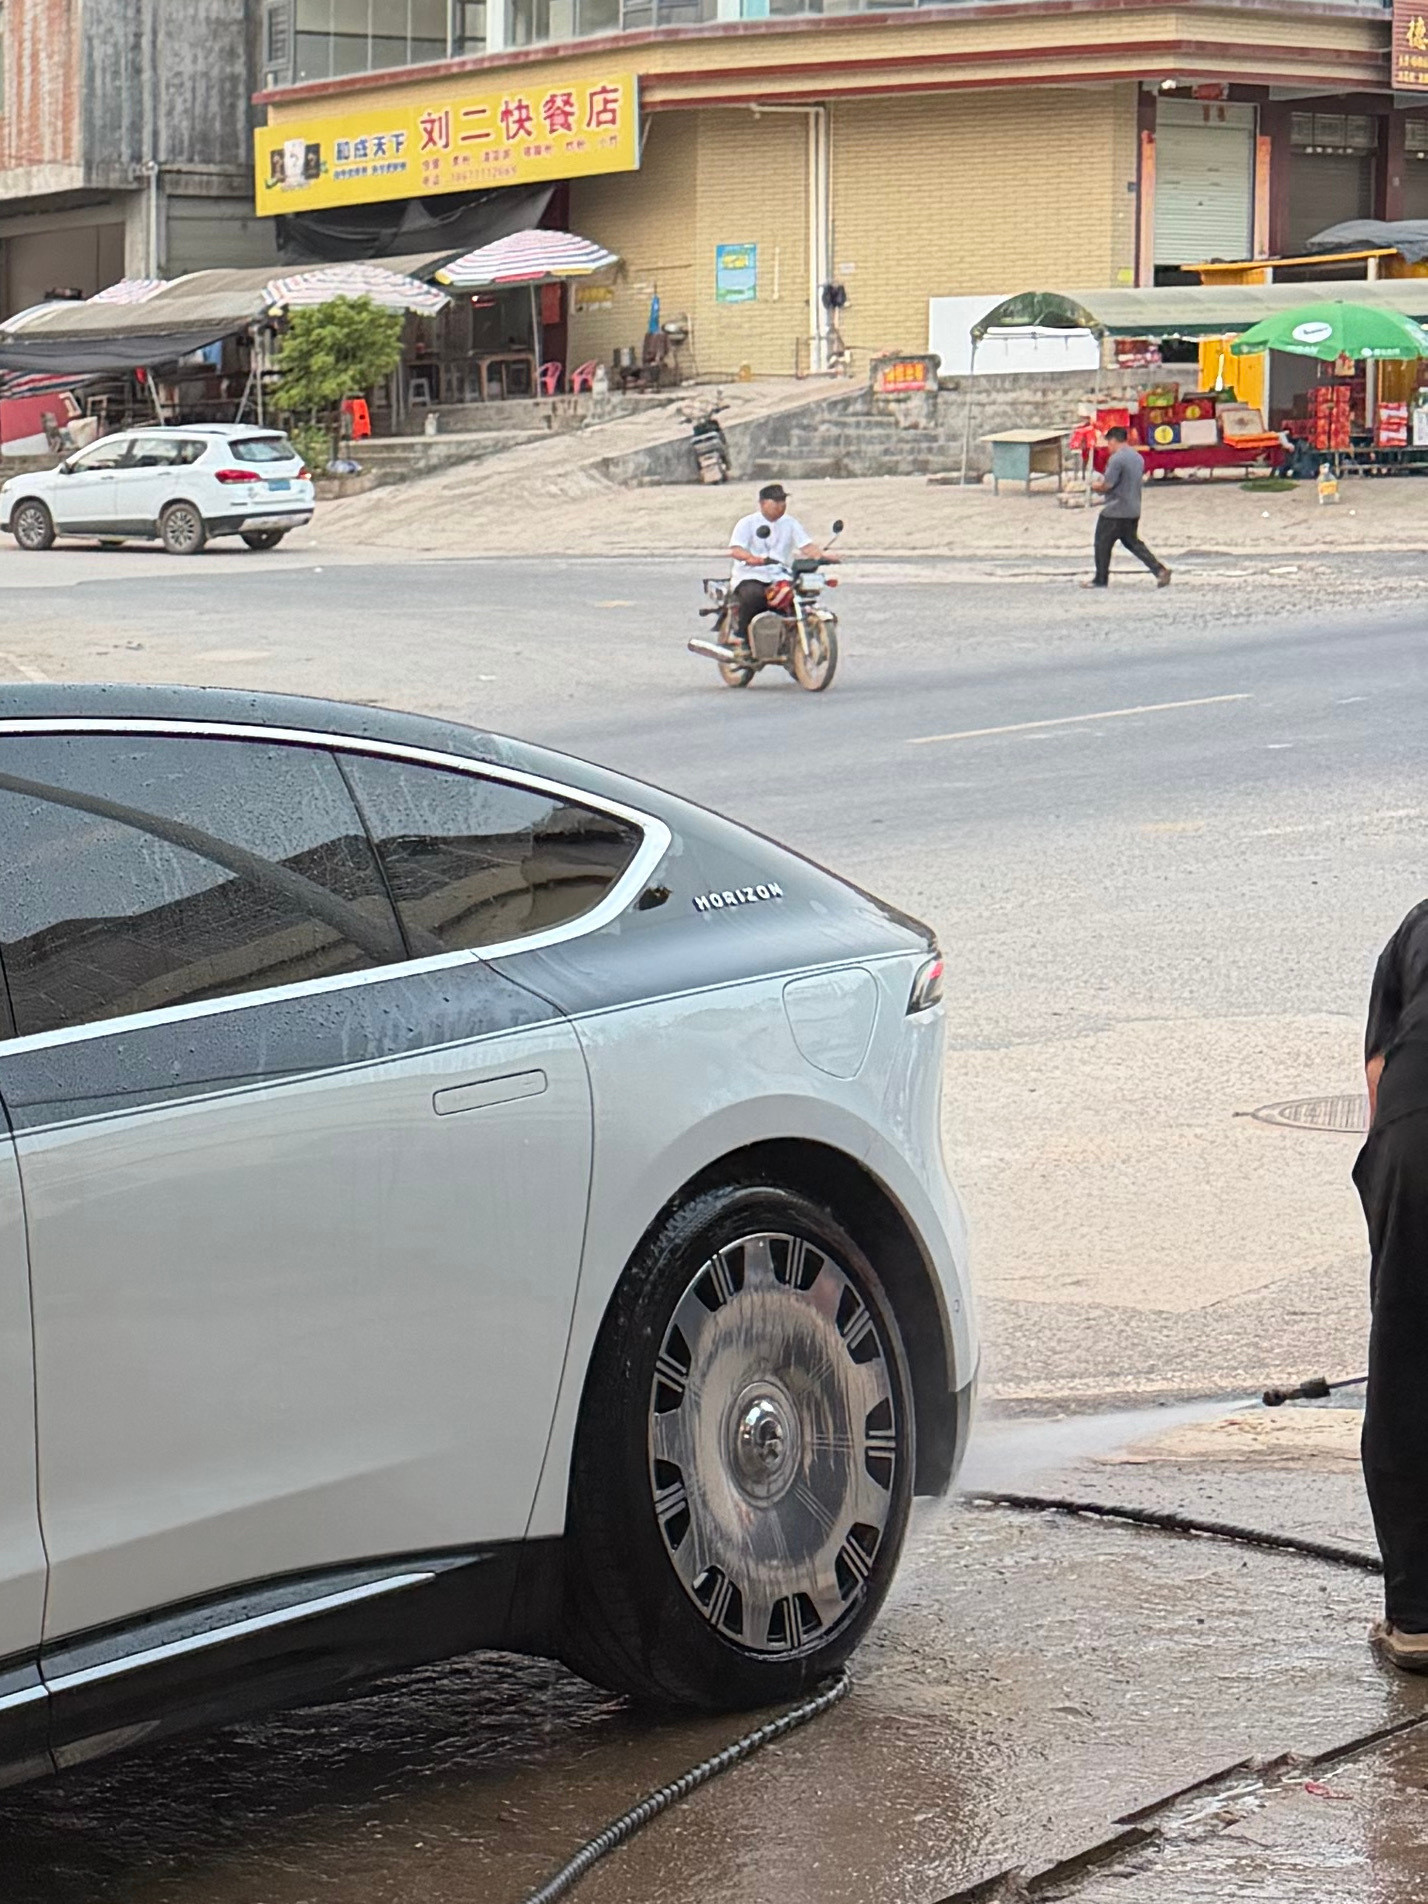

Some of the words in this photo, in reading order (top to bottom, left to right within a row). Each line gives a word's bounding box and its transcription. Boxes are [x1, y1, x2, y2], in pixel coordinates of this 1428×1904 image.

[420, 85, 620, 151] 刘二快餐店
[694, 881, 784, 913] HORIZON
